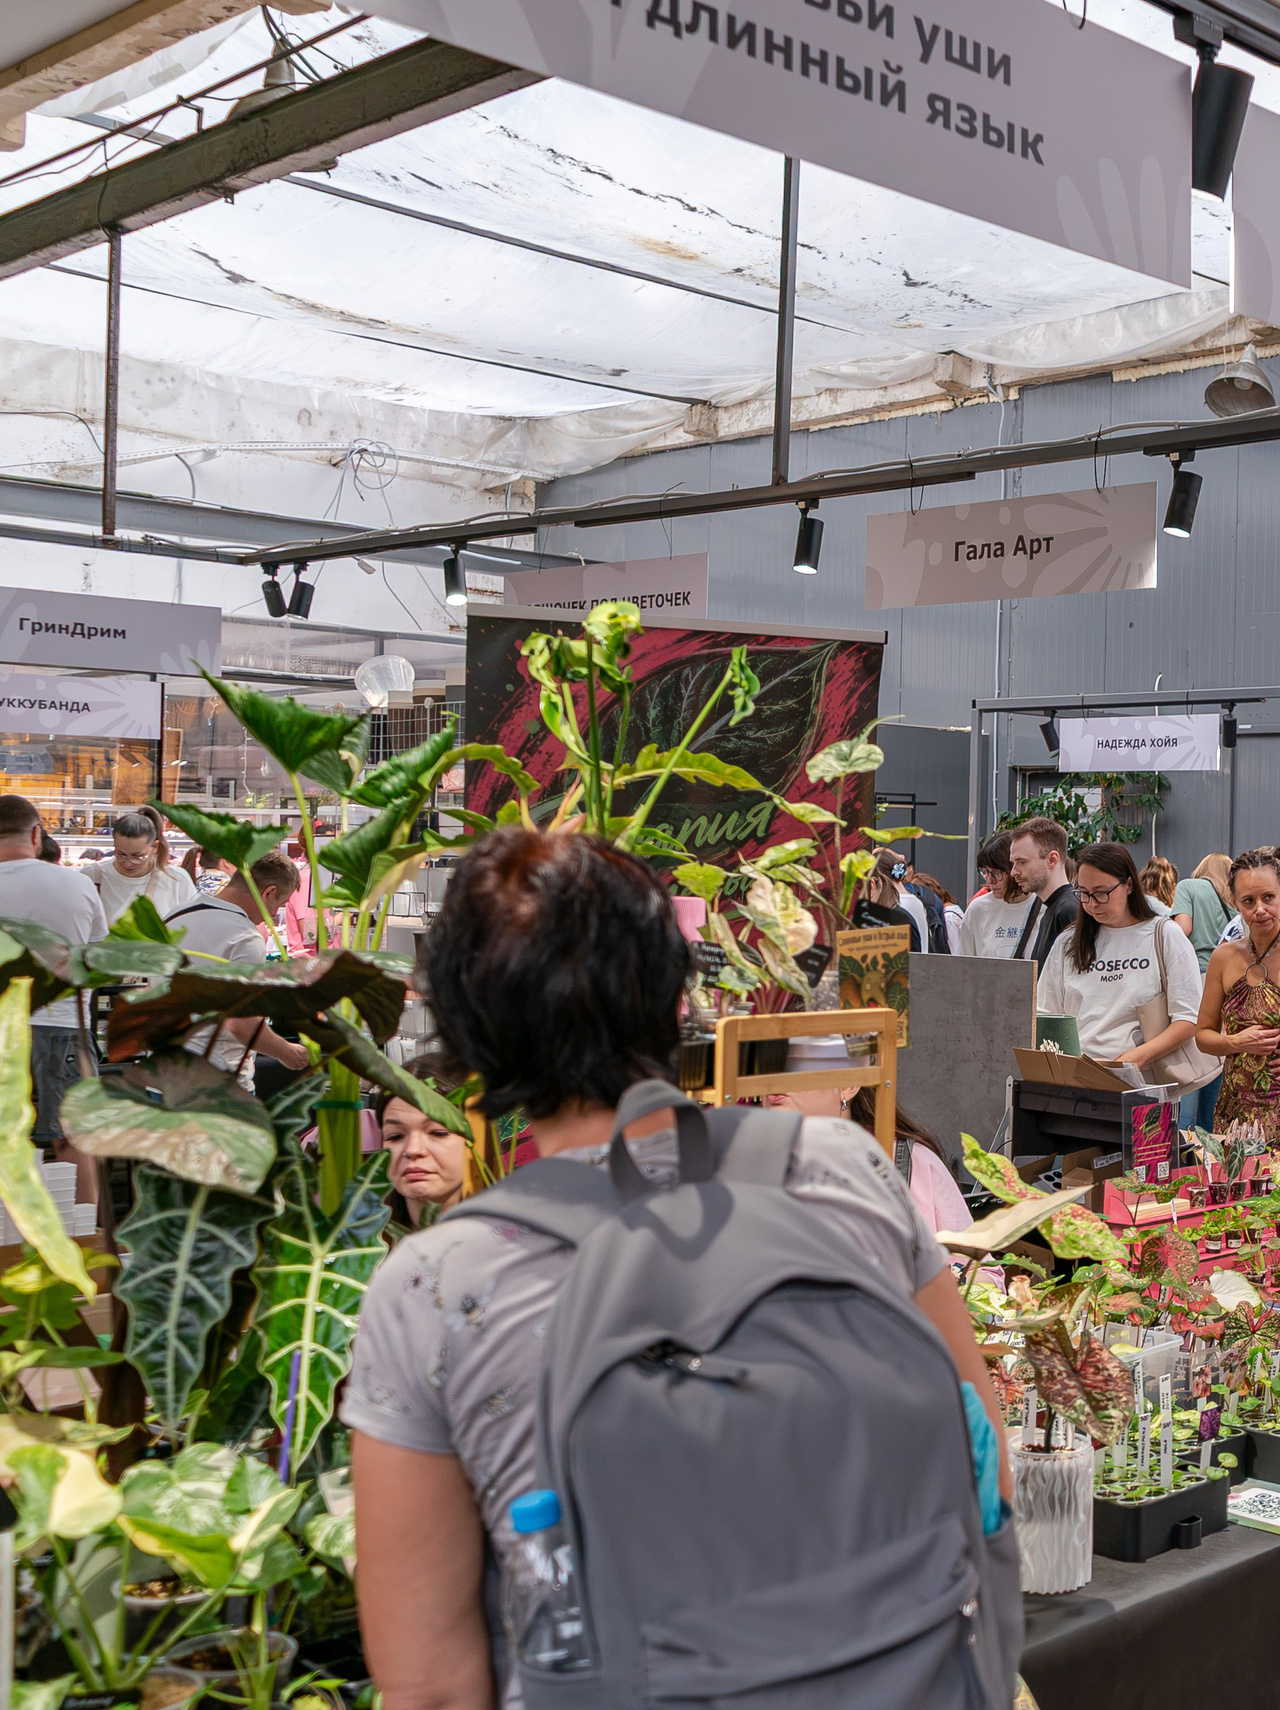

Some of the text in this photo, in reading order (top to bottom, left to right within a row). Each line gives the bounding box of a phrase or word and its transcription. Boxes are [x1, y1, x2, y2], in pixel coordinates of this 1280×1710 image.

[913, 14, 1012, 87] уши
[645, 0, 1045, 166] длинный язык
[954, 533, 1054, 563] Гала Арт
[18, 617, 127, 640] ГринДрим
[1096, 736, 1179, 751] НАДЕЖДА ХОЙЯ
[1100, 973, 1124, 983] MOOD
